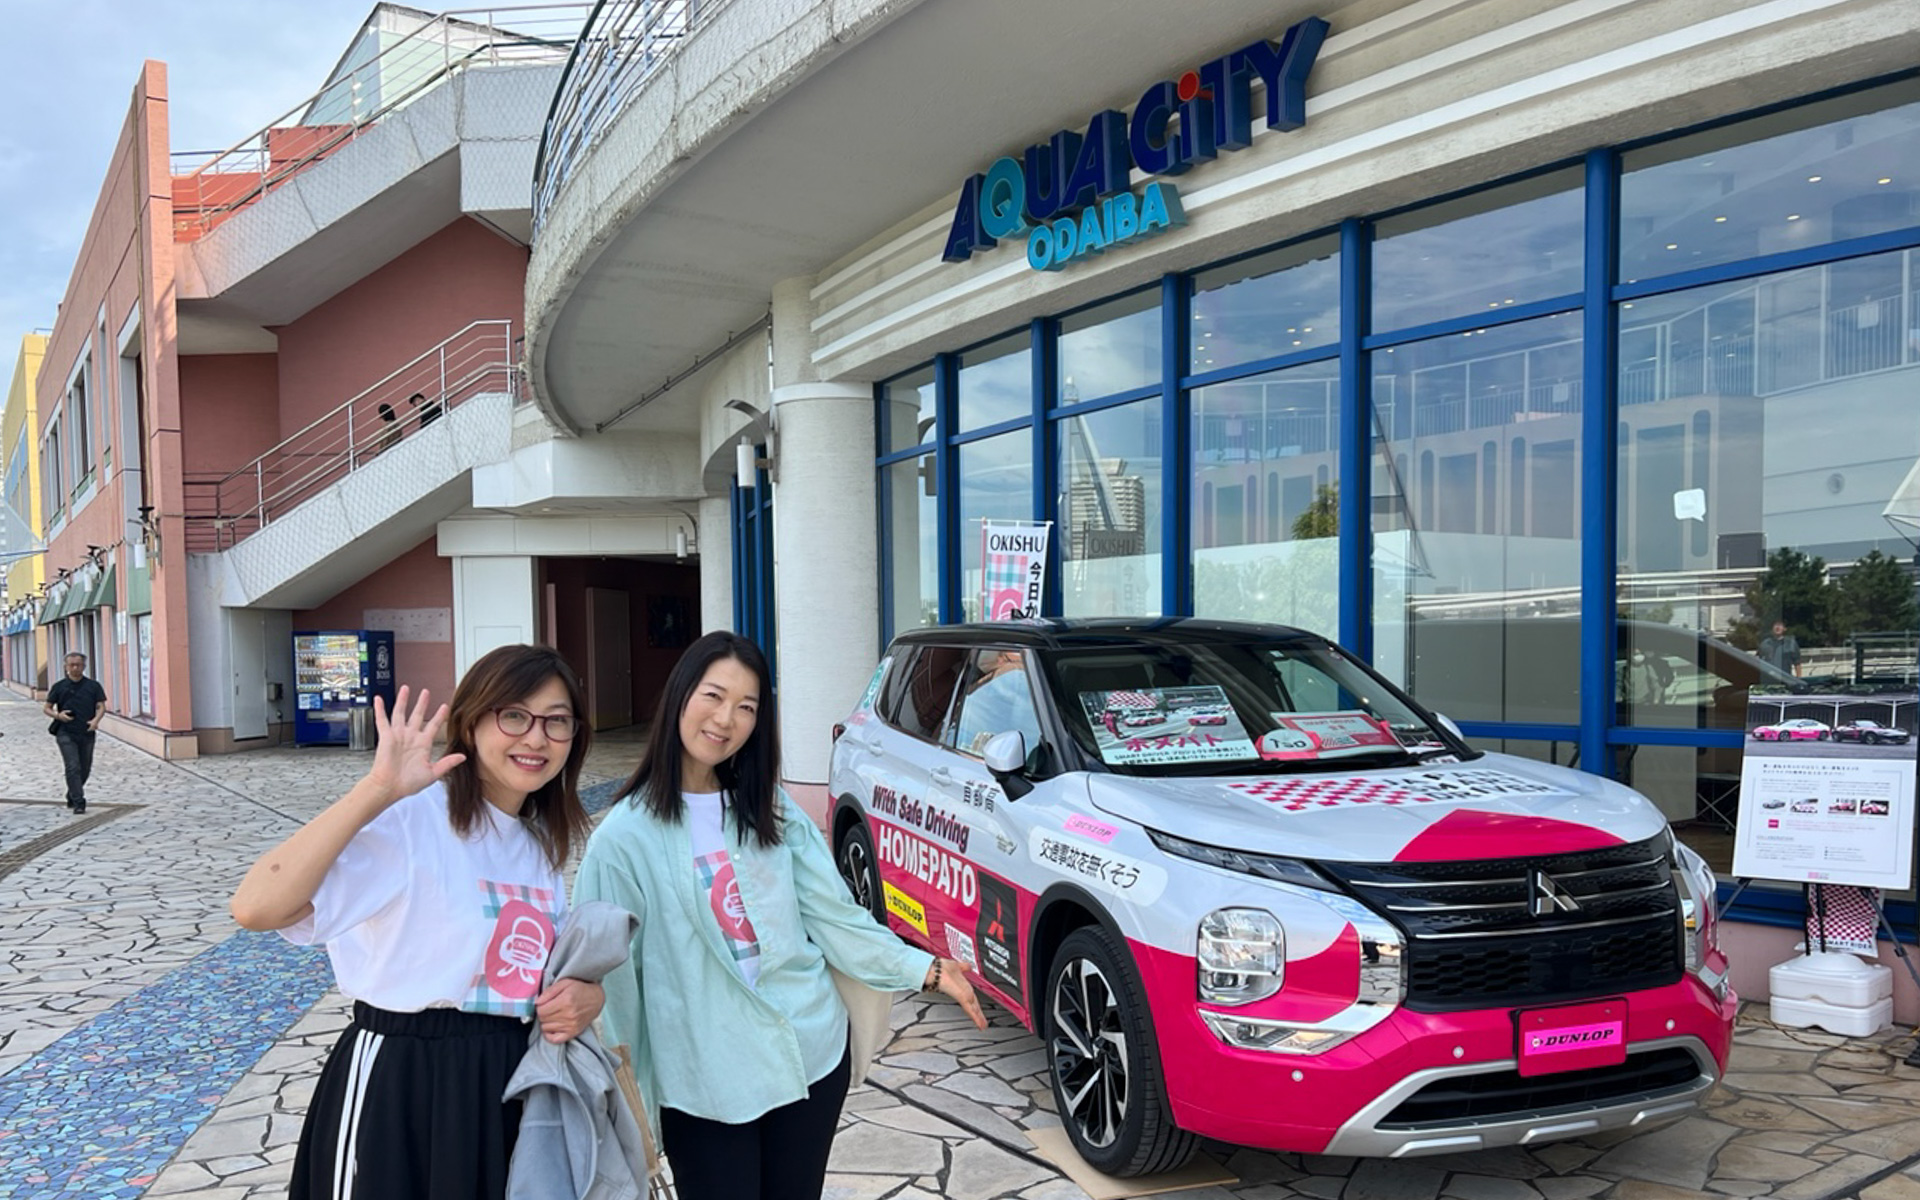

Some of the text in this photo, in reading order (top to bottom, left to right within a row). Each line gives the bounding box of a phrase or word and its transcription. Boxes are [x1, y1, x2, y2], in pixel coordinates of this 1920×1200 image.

[942, 109, 1130, 262] AQUA
[1027, 181, 1188, 272] ODAIBA
[990, 534, 1045, 552] OKISHU
[1382, 771, 1505, 786] JAPAN
[1400, 777, 1528, 792] SMART
[1425, 784, 1561, 800] DRIVER
[872, 785, 898, 815] With
[899, 794, 923, 827] Safe
[925, 804, 970, 854] Driving
[1075, 820, 1112, 837] DUNLOP
[879, 824, 977, 907] HOMEPATO
[1040, 838, 1141, 888] 交通事故を無くそう
[893, 895, 923, 923] DUNLOP
[1545, 1029, 1614, 1046] DUNLOP
